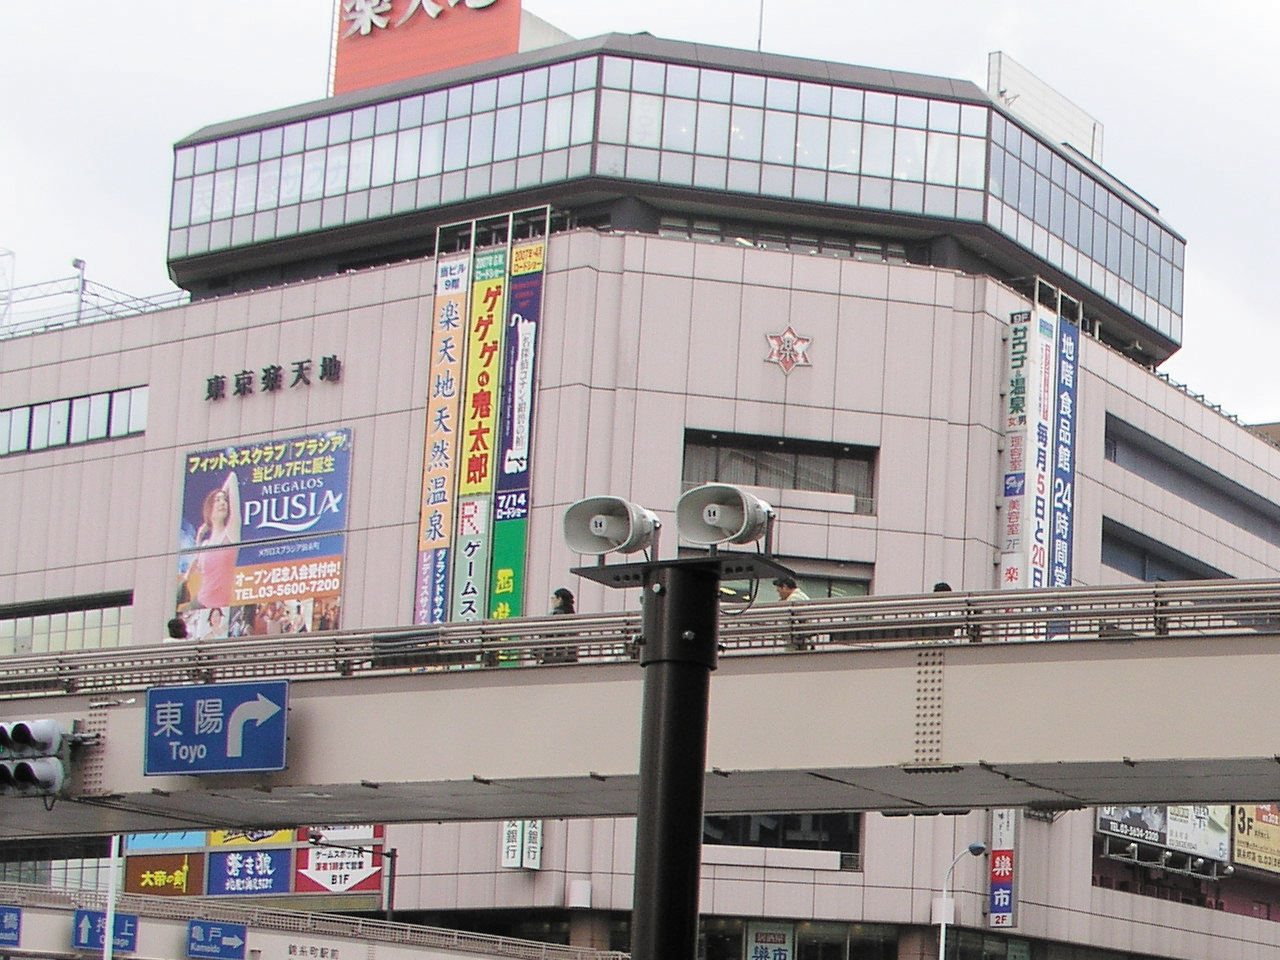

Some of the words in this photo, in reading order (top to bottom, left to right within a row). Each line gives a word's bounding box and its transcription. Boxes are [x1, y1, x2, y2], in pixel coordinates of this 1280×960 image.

[205, 354, 343, 401] 東京楽天地
[466, 284, 502, 485] ゲゲゲの鬼太郎
[426, 299, 460, 541] 楽天地天然温泉
[251, 455, 336, 484] 当ビル7Fに誕生
[261, 476, 324, 497] MEGALOS
[243, 490, 343, 532] PLUSIA
[498, 493, 527, 509] 7/14
[1005, 538, 1020, 550] 7F
[235, 577, 340, 601] TEL.03-5600-7200
[419, 551, 432, 625] レディスサウ
[433, 549, 447, 624] グランドサウ
[460, 540, 481, 622] ゲームス
[153, 698, 225, 738] 東陽
[169, 741, 208, 762] Toyo
[331, 874, 350, 885] B1F
[995, 914, 1008, 925] 2F
